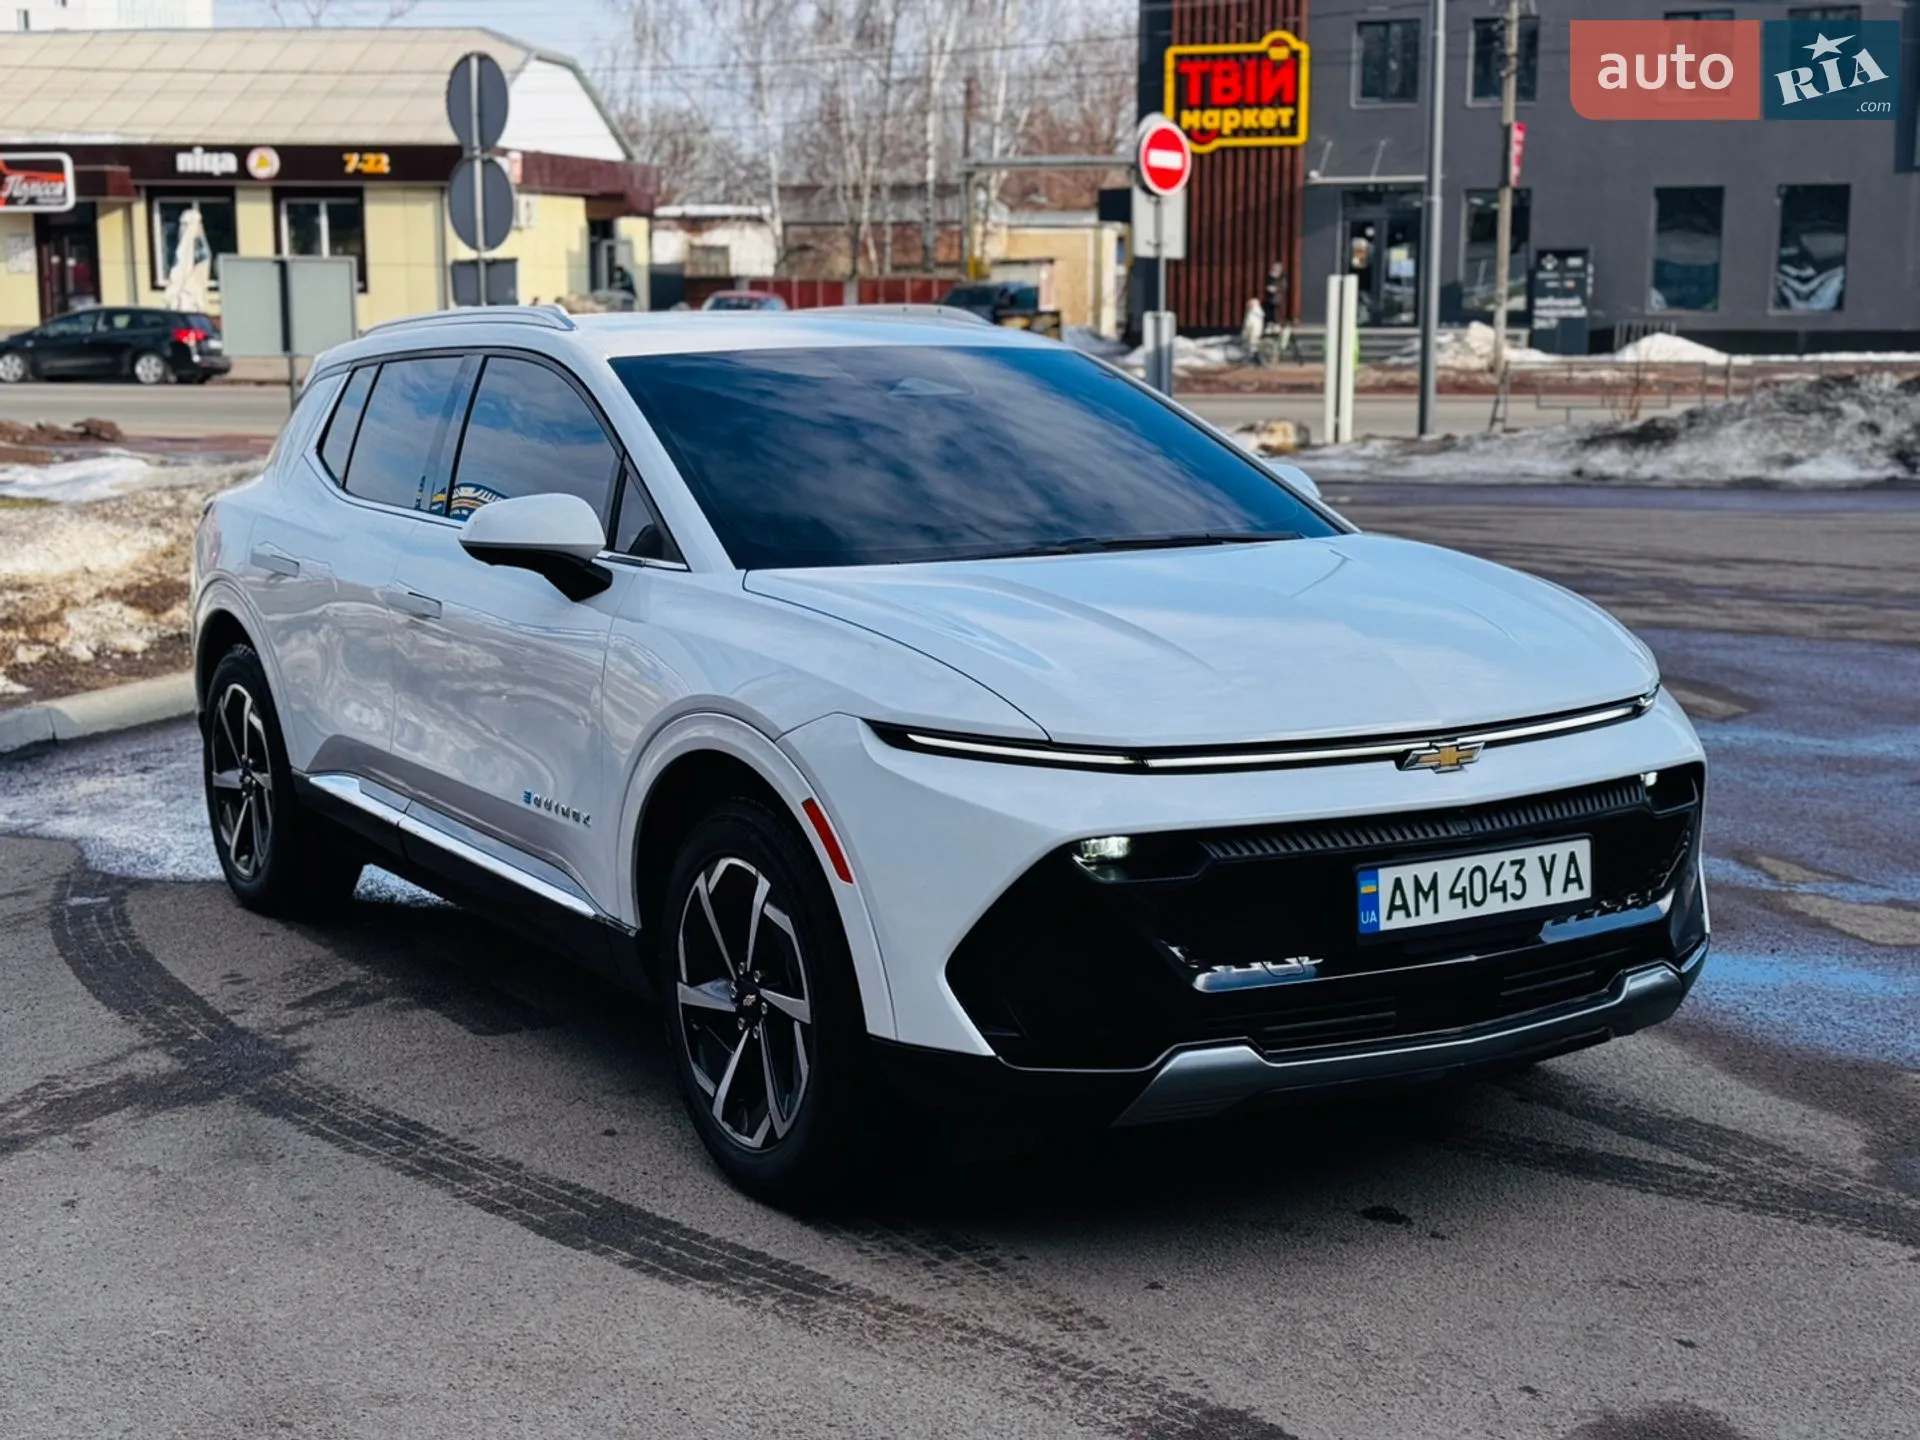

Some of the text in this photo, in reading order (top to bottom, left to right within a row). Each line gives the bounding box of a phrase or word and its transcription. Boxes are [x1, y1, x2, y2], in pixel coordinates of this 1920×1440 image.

[1178, 47, 1296, 106] ТВІЙ
[1180, 106, 1295, 136] маркет
[1386, 850, 1585, 921] AM 4043 YA
[1361, 909, 1378, 924] UA
